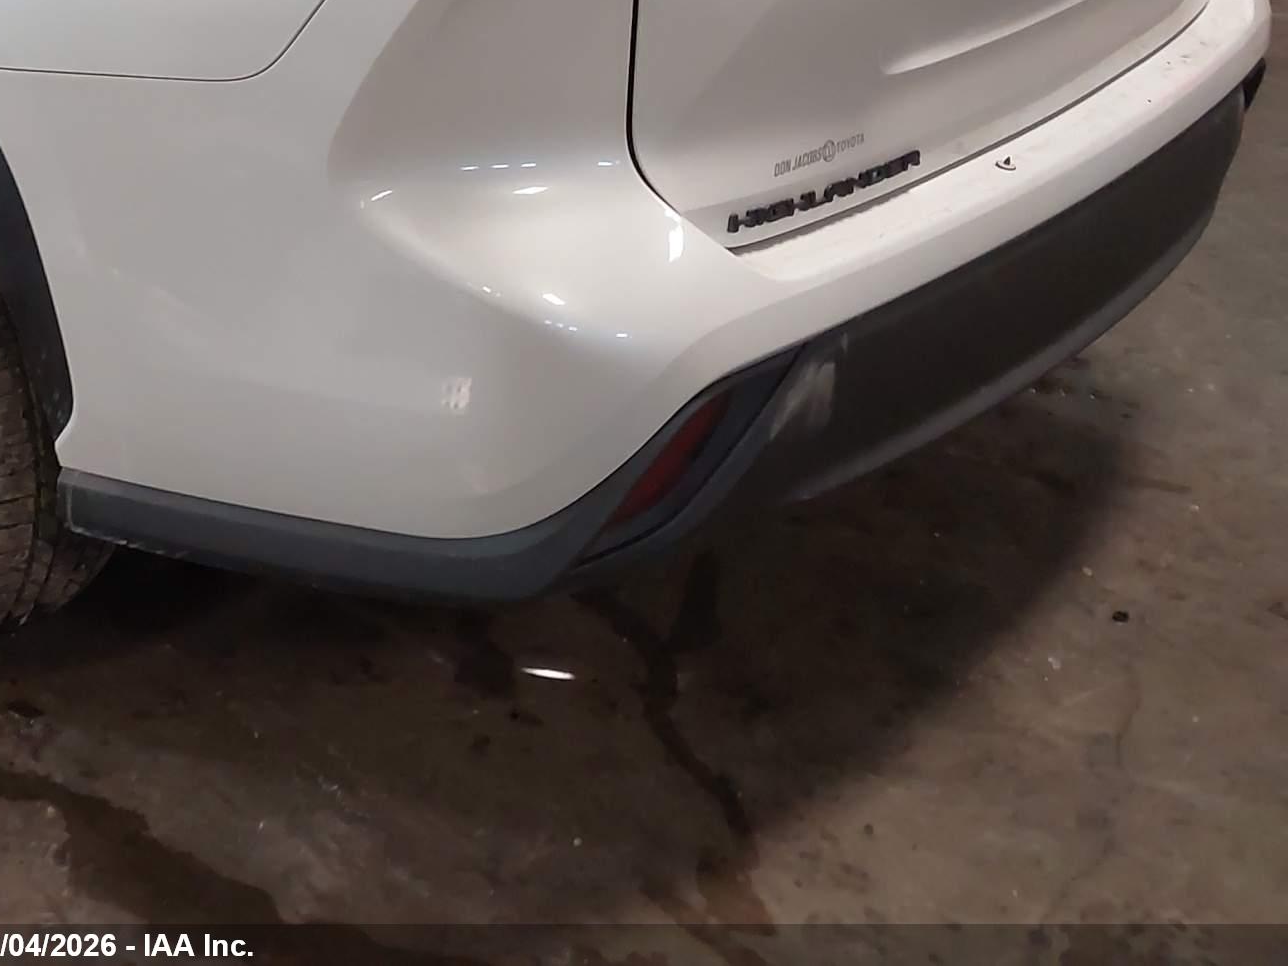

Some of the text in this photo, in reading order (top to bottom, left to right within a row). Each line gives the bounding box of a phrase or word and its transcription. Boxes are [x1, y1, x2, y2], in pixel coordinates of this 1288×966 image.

[773, 133, 865, 177] DON JACOBS TOYOTA
[727, 149, 921, 233] HIGHLANDER
